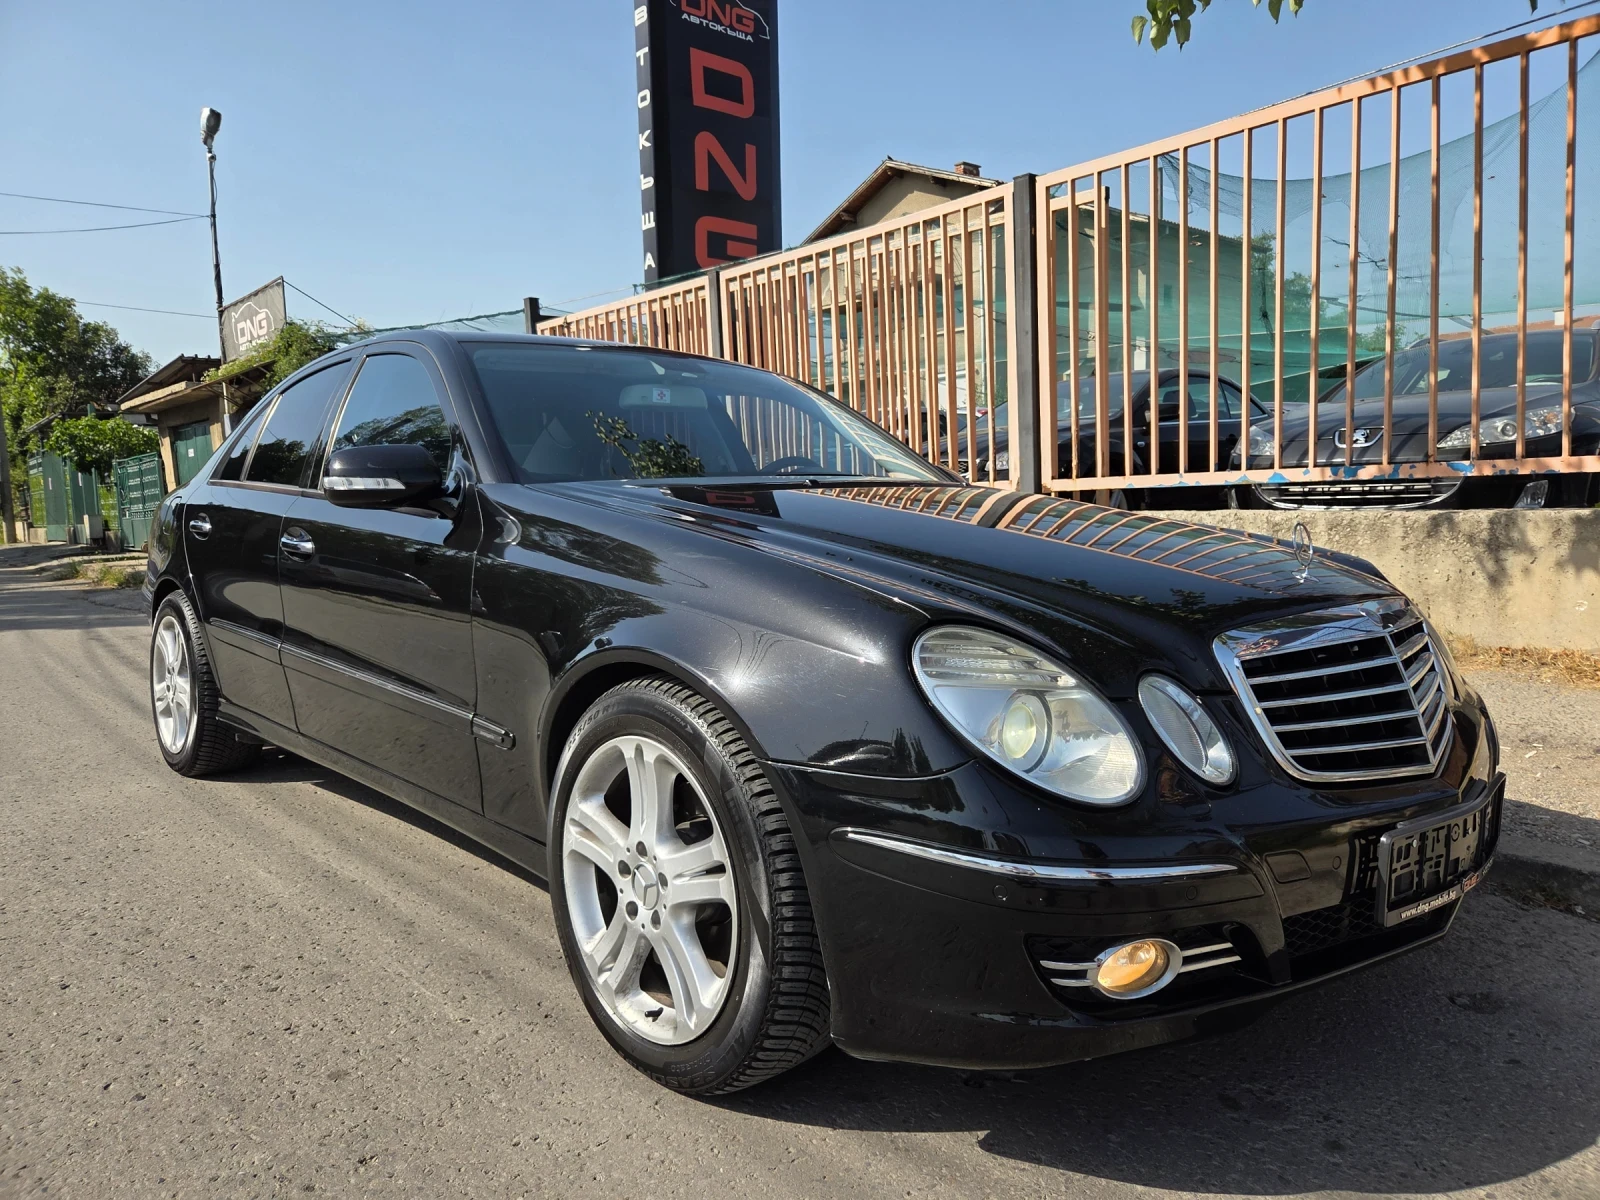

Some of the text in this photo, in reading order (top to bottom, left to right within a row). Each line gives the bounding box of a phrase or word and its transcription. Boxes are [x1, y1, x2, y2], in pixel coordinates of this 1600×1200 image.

[681, 0, 756, 34] DNG
[681, 13, 754, 42] АВТОКЪЩА
[236, 311, 268, 345] DNG
[1400, 889, 1457, 919] www.dng.mobile.bg
